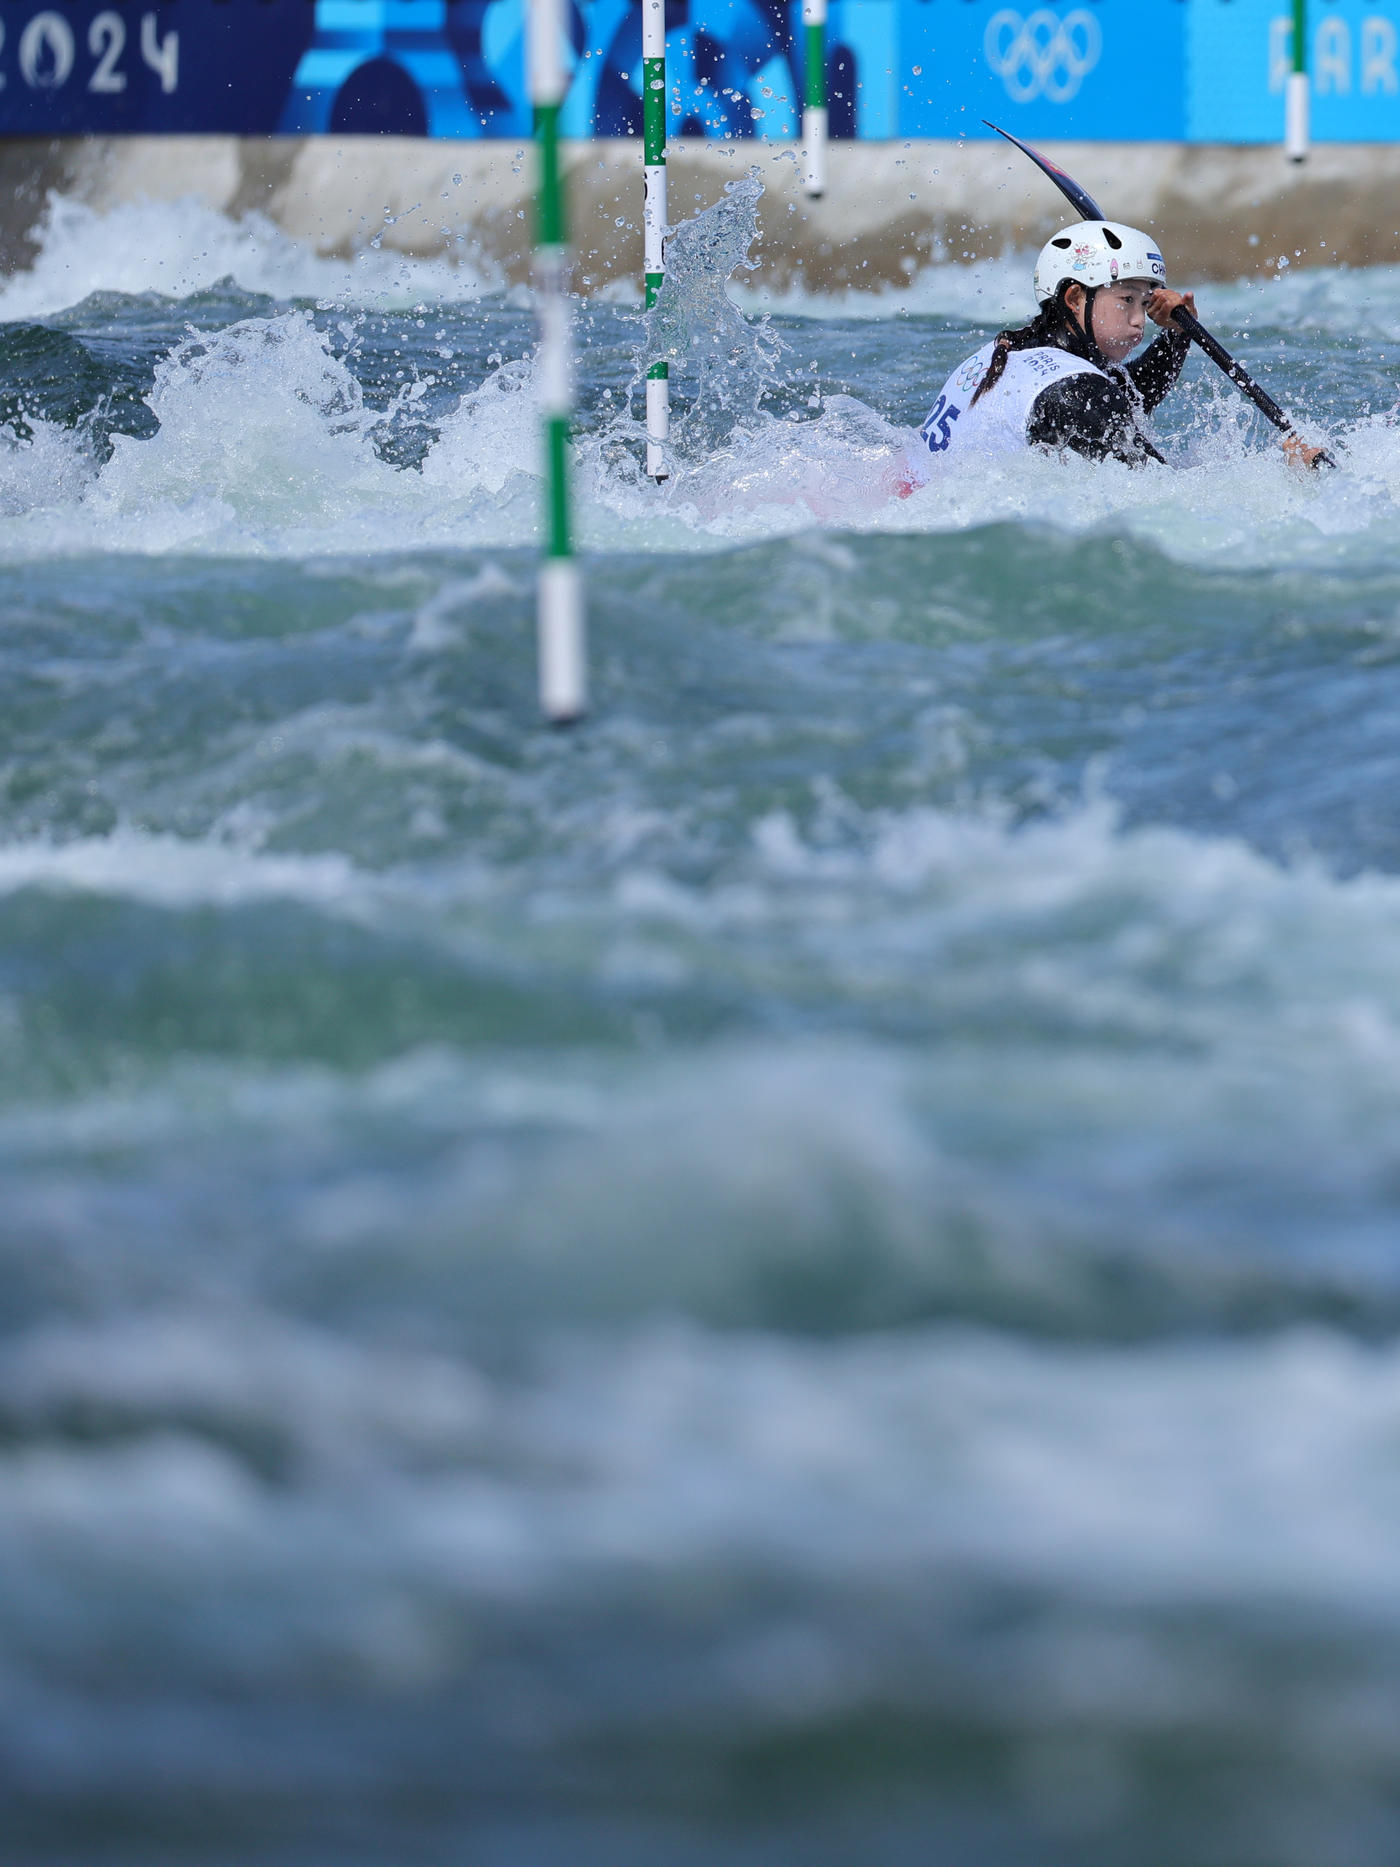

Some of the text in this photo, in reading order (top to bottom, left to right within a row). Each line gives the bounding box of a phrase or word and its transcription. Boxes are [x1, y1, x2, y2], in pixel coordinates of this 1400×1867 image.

[0, 10, 179, 94] 024
[1023, 356, 1048, 376] 2024
[920, 395, 961, 452] 25
